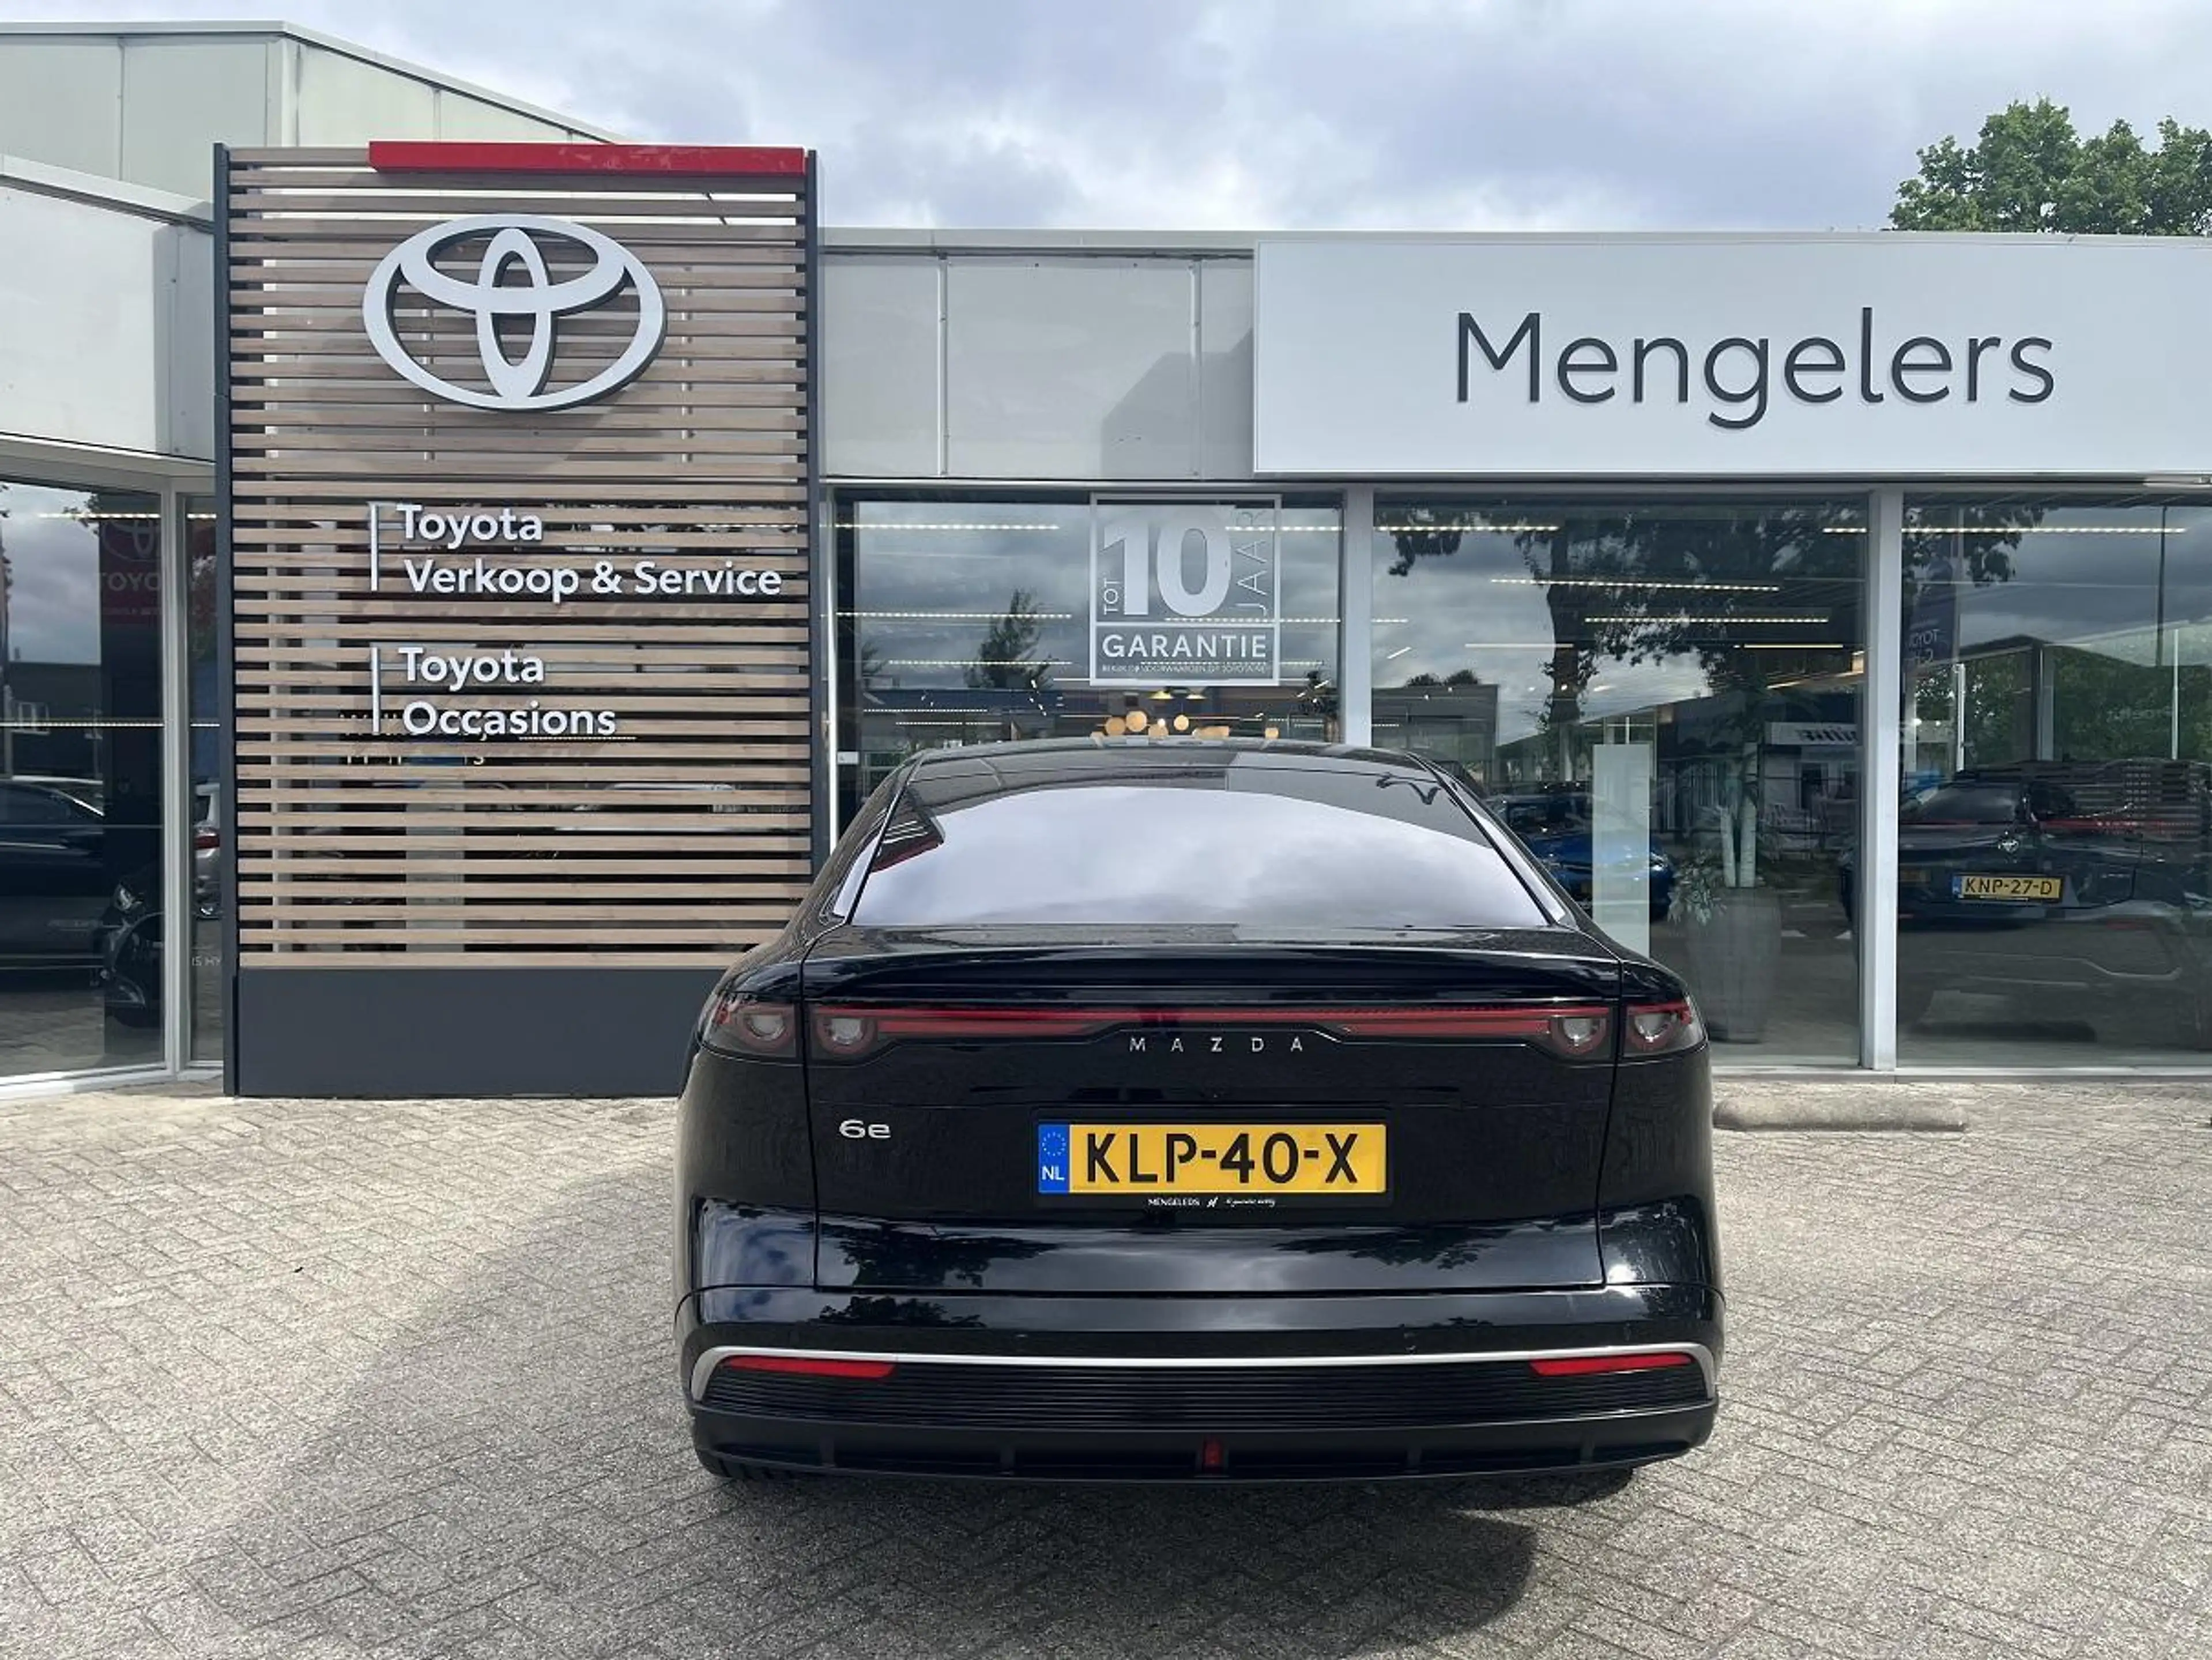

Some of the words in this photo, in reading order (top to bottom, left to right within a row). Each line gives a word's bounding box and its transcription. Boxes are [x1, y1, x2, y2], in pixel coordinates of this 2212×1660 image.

[1457, 307, 2055, 429] Mengelers
[396, 504, 543, 549] Toyota
[404, 558, 579, 605] Verkoop
[590, 561, 622, 594] &
[634, 560, 782, 595] Service
[1099, 507, 1232, 617] 10
[1235, 511, 1268, 616] JAAR
[1103, 578, 1121, 615] TOT
[1102, 634, 1267, 658] GARANTIE
[397, 647, 544, 692] Toyota
[403, 700, 616, 736] Occasions
[1965, 877, 2053, 895] KNP-27-D
[1129, 1037, 1303, 1052] MAZDA
[839, 1119, 891, 1138] 6e
[1042, 1167, 1065, 1182] NL
[1087, 1132, 1358, 1184] KLP-40-X
